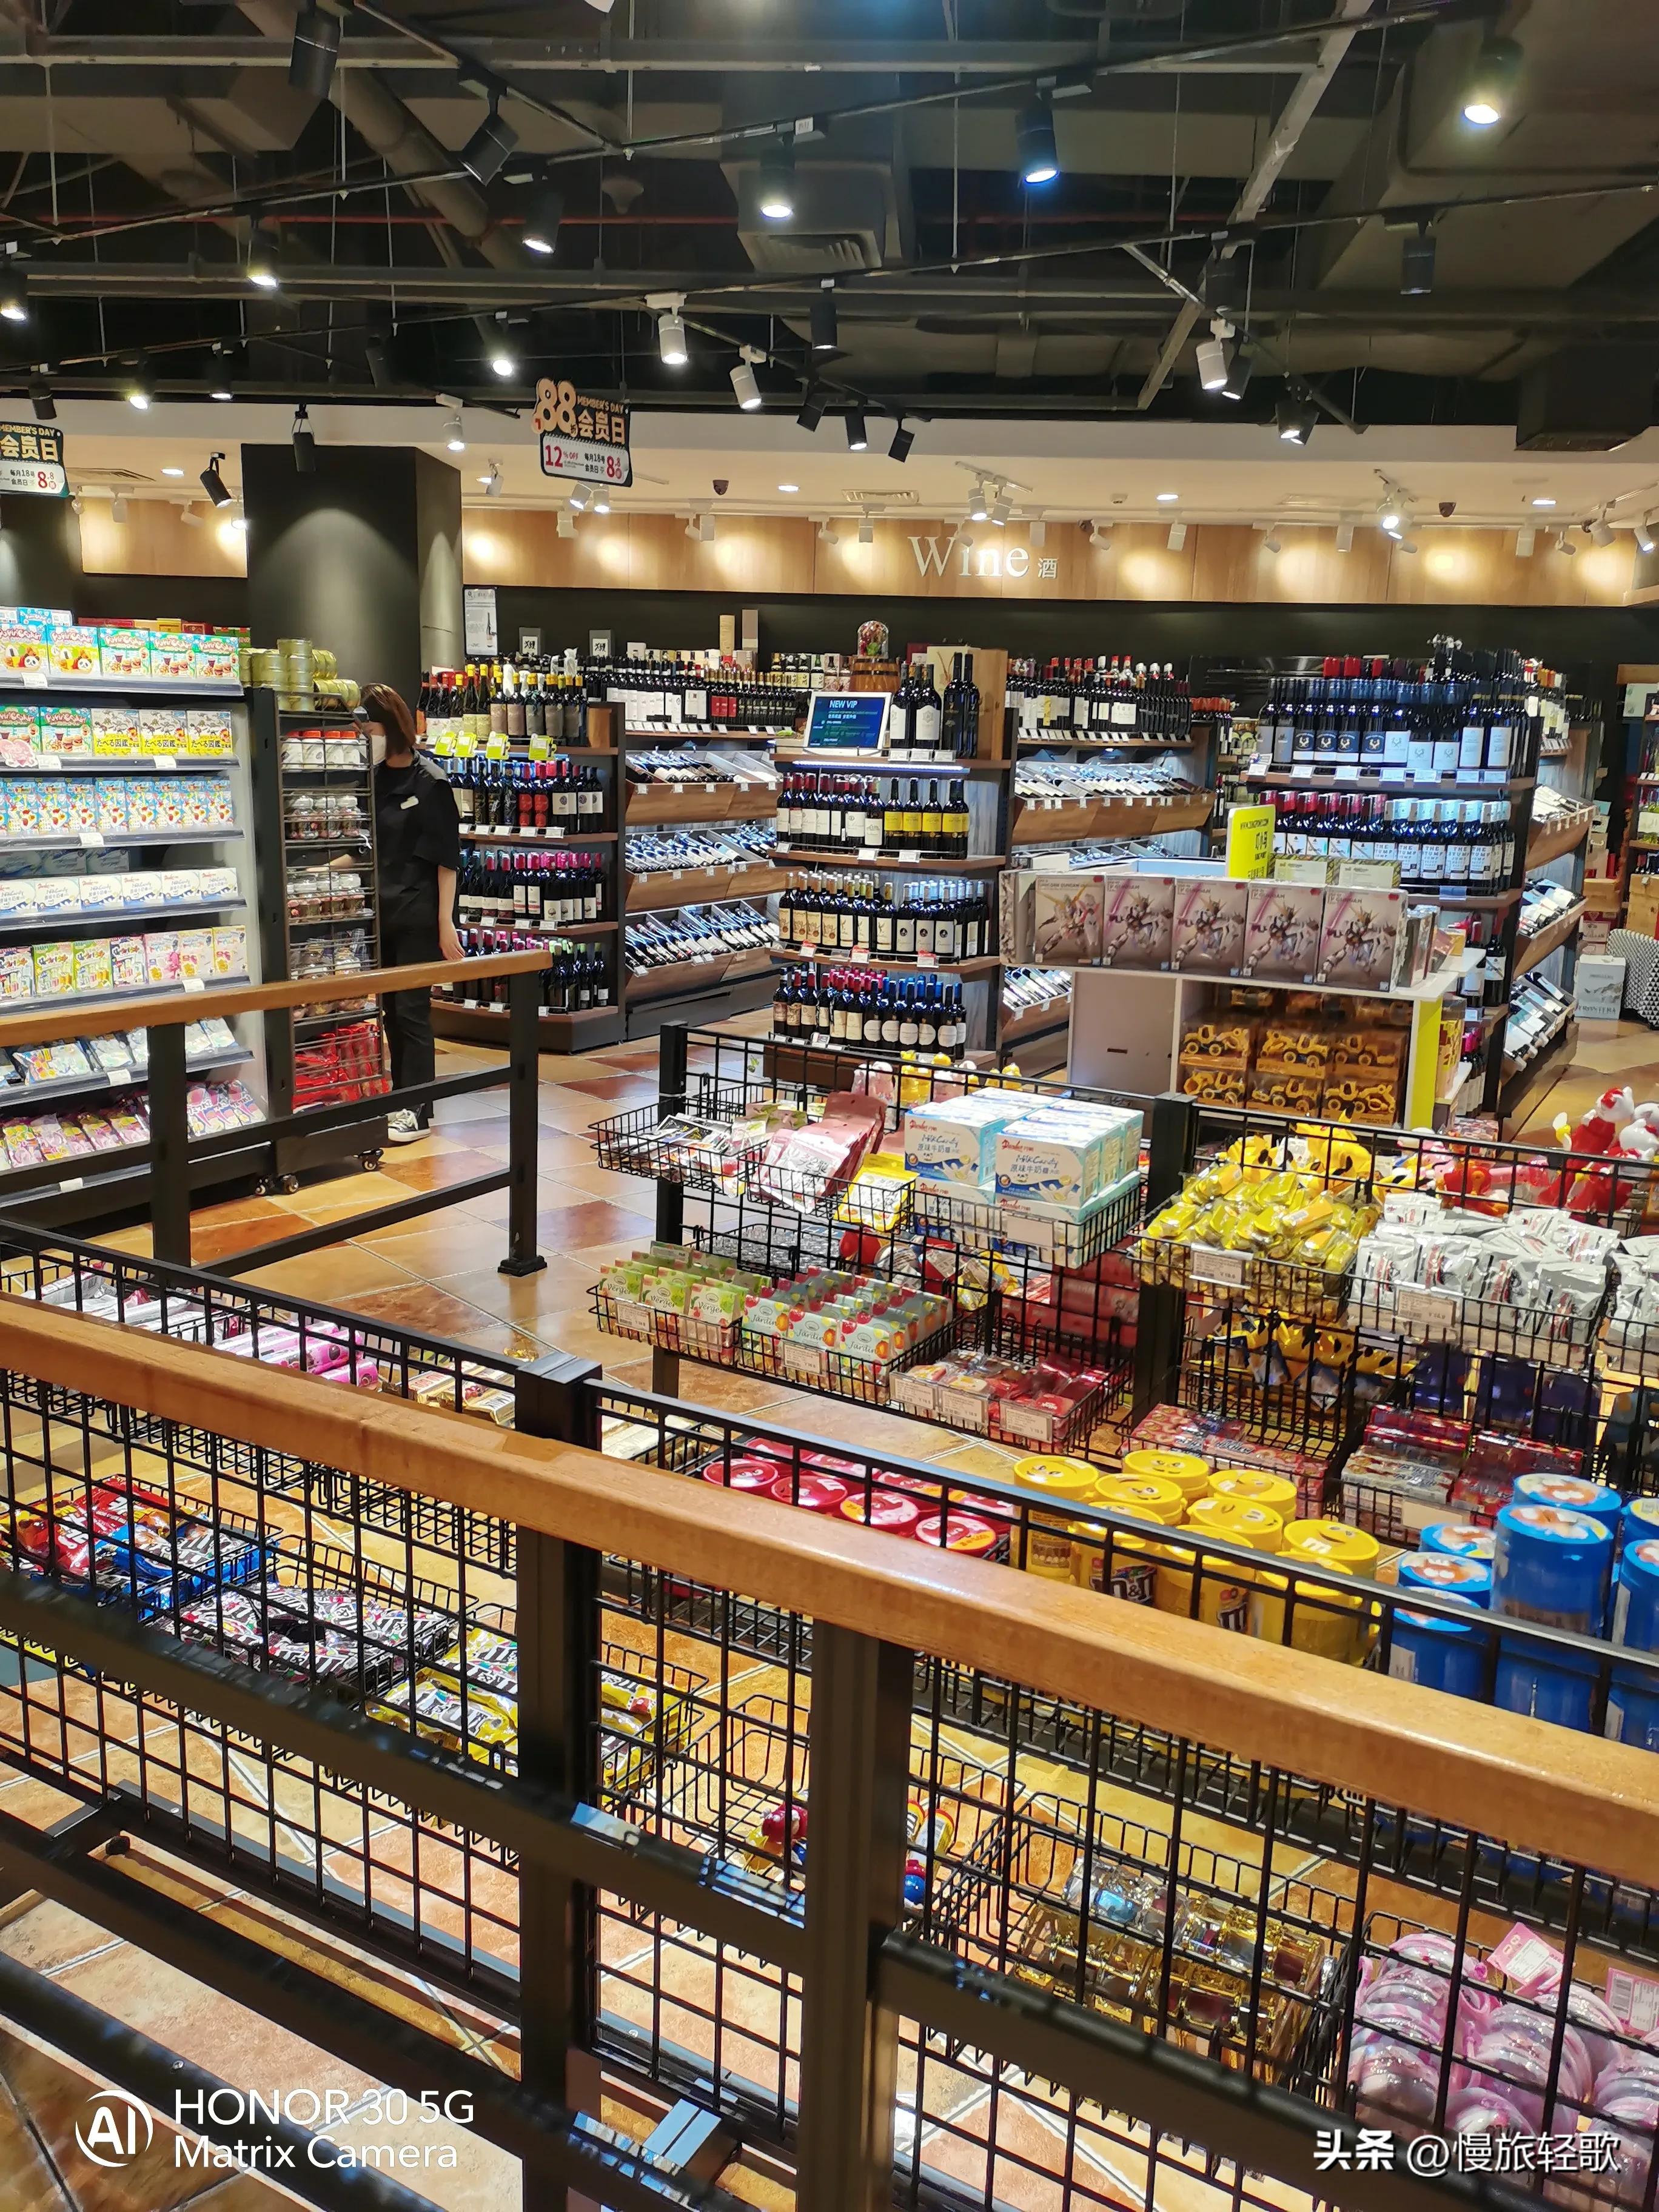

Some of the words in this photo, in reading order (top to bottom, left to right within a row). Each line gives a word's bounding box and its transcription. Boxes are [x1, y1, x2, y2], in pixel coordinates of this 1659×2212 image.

[610, 403, 624, 414] DAY
[38, 427, 55, 437] DAY
[577, 409, 625, 444] 会员日
[0, 434, 59, 462] 会员日
[545, 444, 563, 468] 12
[907, 536, 1030, 578] Wine
[1037, 557, 1058, 579] 酒
[830, 700, 846, 709] NEW
[846, 700, 858, 709] VIP
[751, 1314, 778, 1325] Jardin
[797, 1328, 825, 1341] Jardin
[849, 1340, 878, 1354] Jardin
